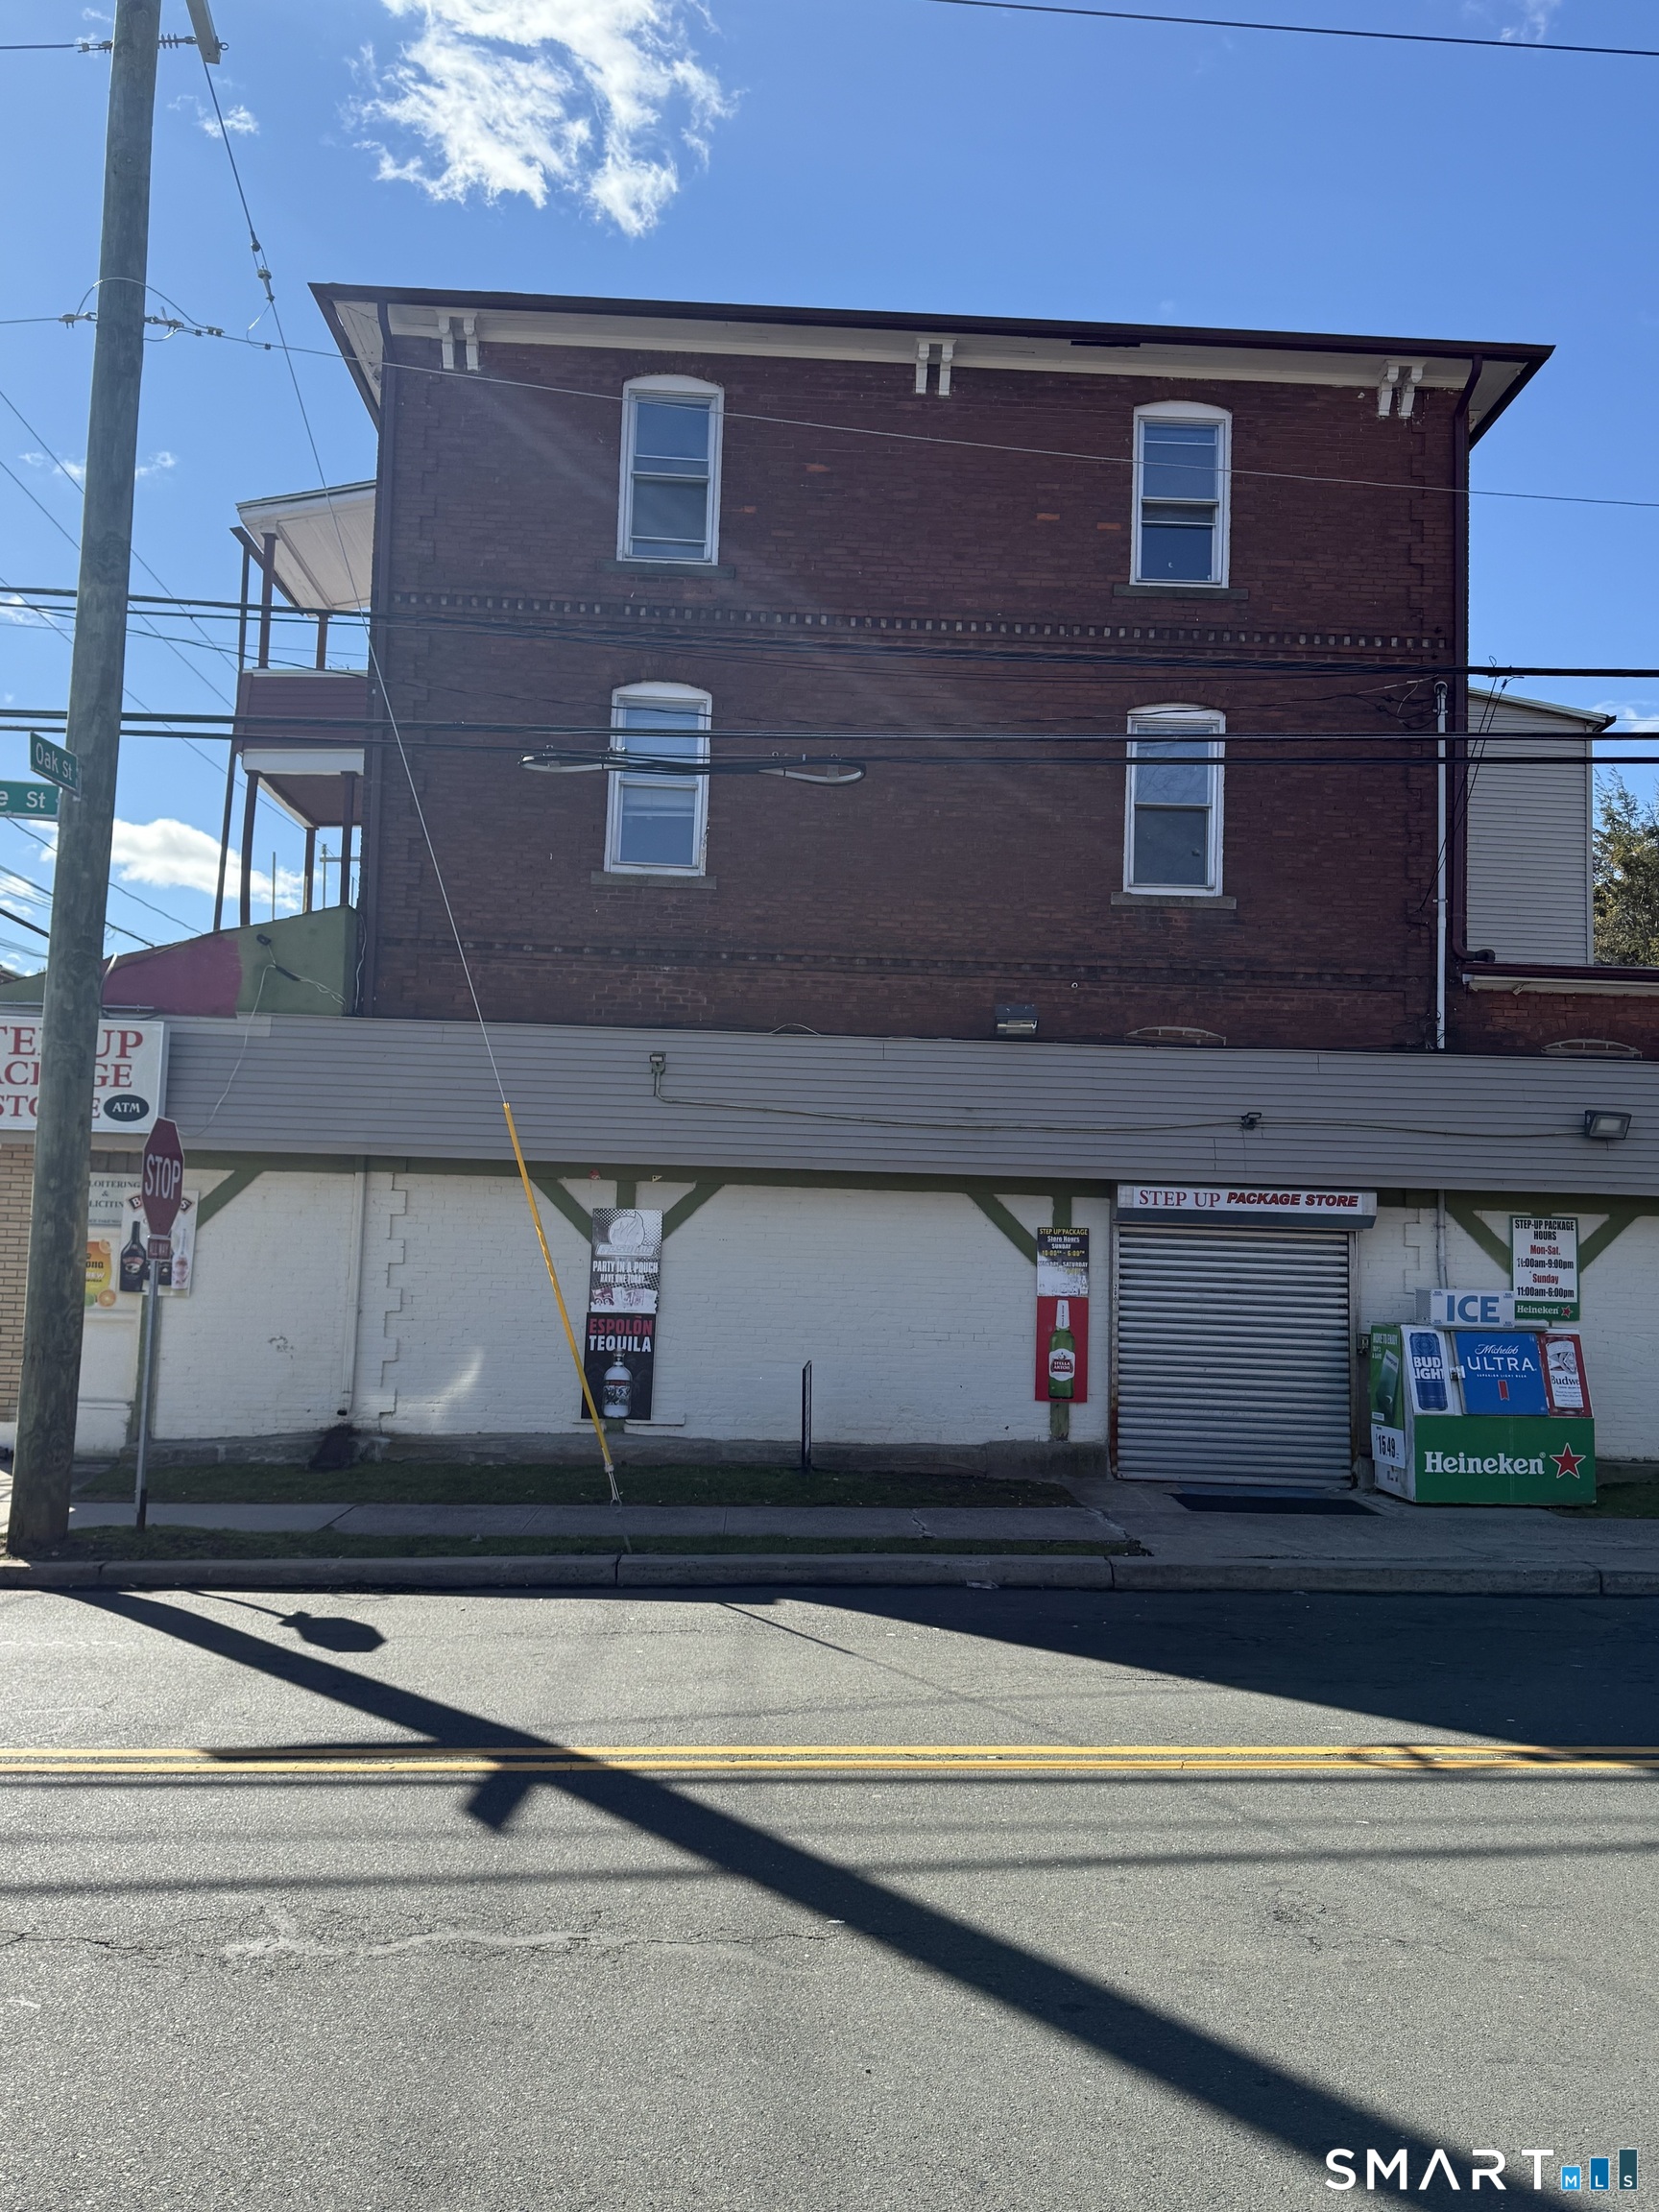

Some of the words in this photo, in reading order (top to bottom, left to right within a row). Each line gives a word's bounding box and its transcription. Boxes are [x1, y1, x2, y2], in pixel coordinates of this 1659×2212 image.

[36, 742, 60, 774] Oak
[62, 758, 72, 781] St
[26, 790, 45, 809] St
[112, 1102, 141, 1114] ATM
[144, 1153, 180, 1200] STOP
[88, 1200, 124, 1209] LICITIN
[1139, 1190, 1187, 1207] STEP
[1193, 1191, 1221, 1208] UP
[1226, 1191, 1301, 1206] PACKAGE
[1305, 1193, 1358, 1208] STORE
[1515, 1219, 1543, 1230] STEP-UP
[1544, 1220, 1575, 1231] PACKAGE
[1533, 1231, 1557, 1240] HOURS
[1529, 1244, 1561, 1256] Mon-Sat.
[592, 1261, 615, 1273] PARTY
[616, 1261, 625, 1273] IN
[634, 1262, 659, 1274] POUCH
[1532, 1273, 1559, 1285] Sunday
[1447, 1295, 1500, 1323] ICE
[1517, 1305, 1559, 1314] Heineken
[589, 1335, 652, 1353] TEQUILA
[1475, 1344, 1519, 1355] Michelob
[1413, 1357, 1440, 1368] BUD
[1467, 1356, 1535, 1371] ULTRA
[1424, 1451, 1545, 1475] Heineken
